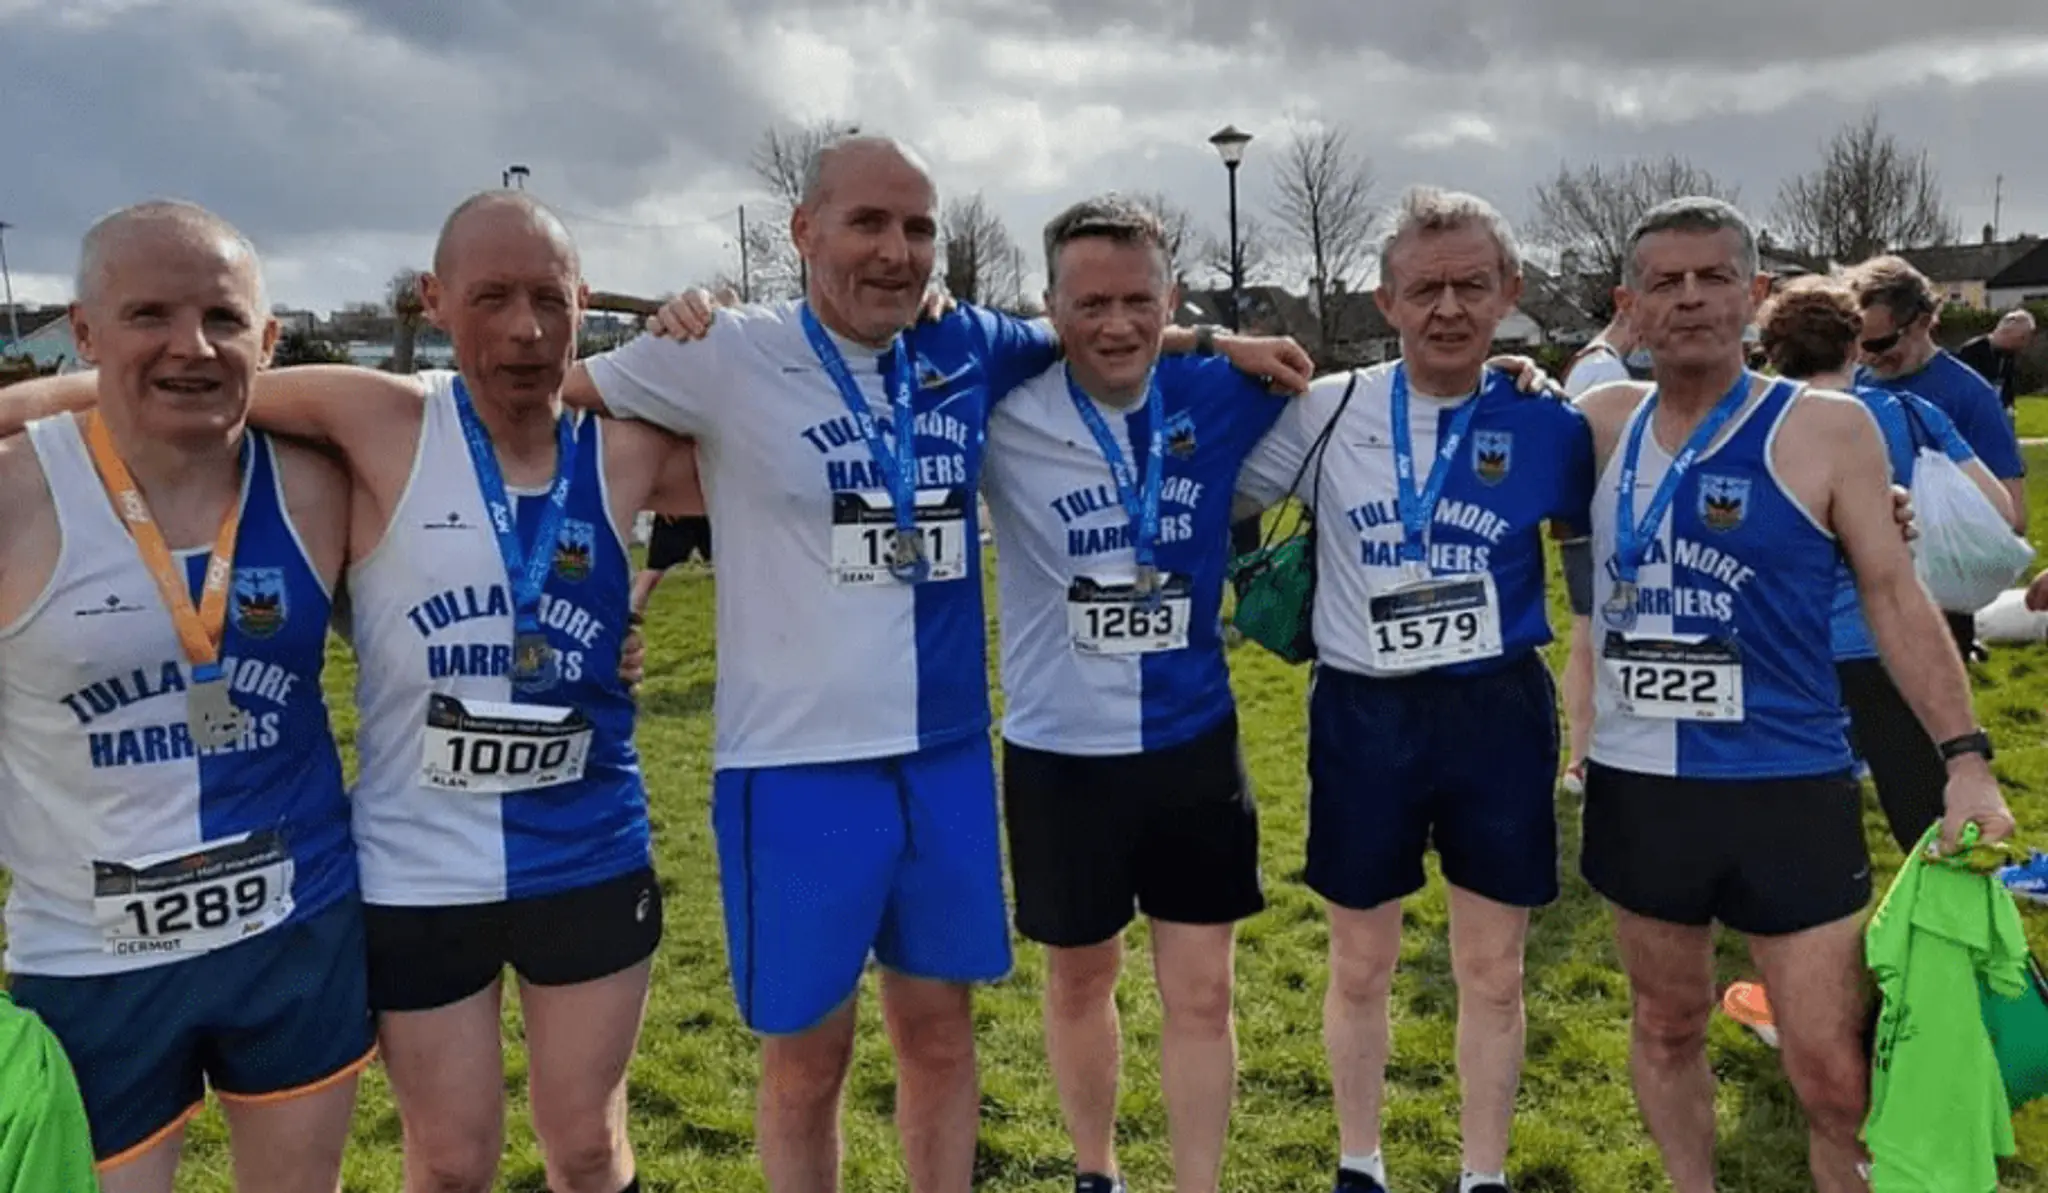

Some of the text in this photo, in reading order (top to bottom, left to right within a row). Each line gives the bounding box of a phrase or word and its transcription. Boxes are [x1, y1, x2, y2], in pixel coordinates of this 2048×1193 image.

[801, 411, 968, 454] TULMORE
[826, 453, 967, 490] HAIERS
[1049, 475, 1204, 523] TULLORE
[1068, 513, 1193, 557] HARRS
[1348, 498, 1510, 545] TULLMORE
[863, 526, 942, 566] 131
[1361, 539, 1491, 574] HAIERS
[1605, 538, 1755, 592] AMORE
[406, 584, 606, 650] TULLAORE
[1085, 605, 1172, 639] 1263
[1635, 586, 1732, 623] RRIERS
[1375, 612, 1478, 653] 1579
[427, 643, 584, 682] HARRS
[1618, 665, 1718, 704] 1222
[89, 711, 280, 769] HARRRS
[446, 735, 571, 776] 1000
[124, 875, 267, 936] 1289
